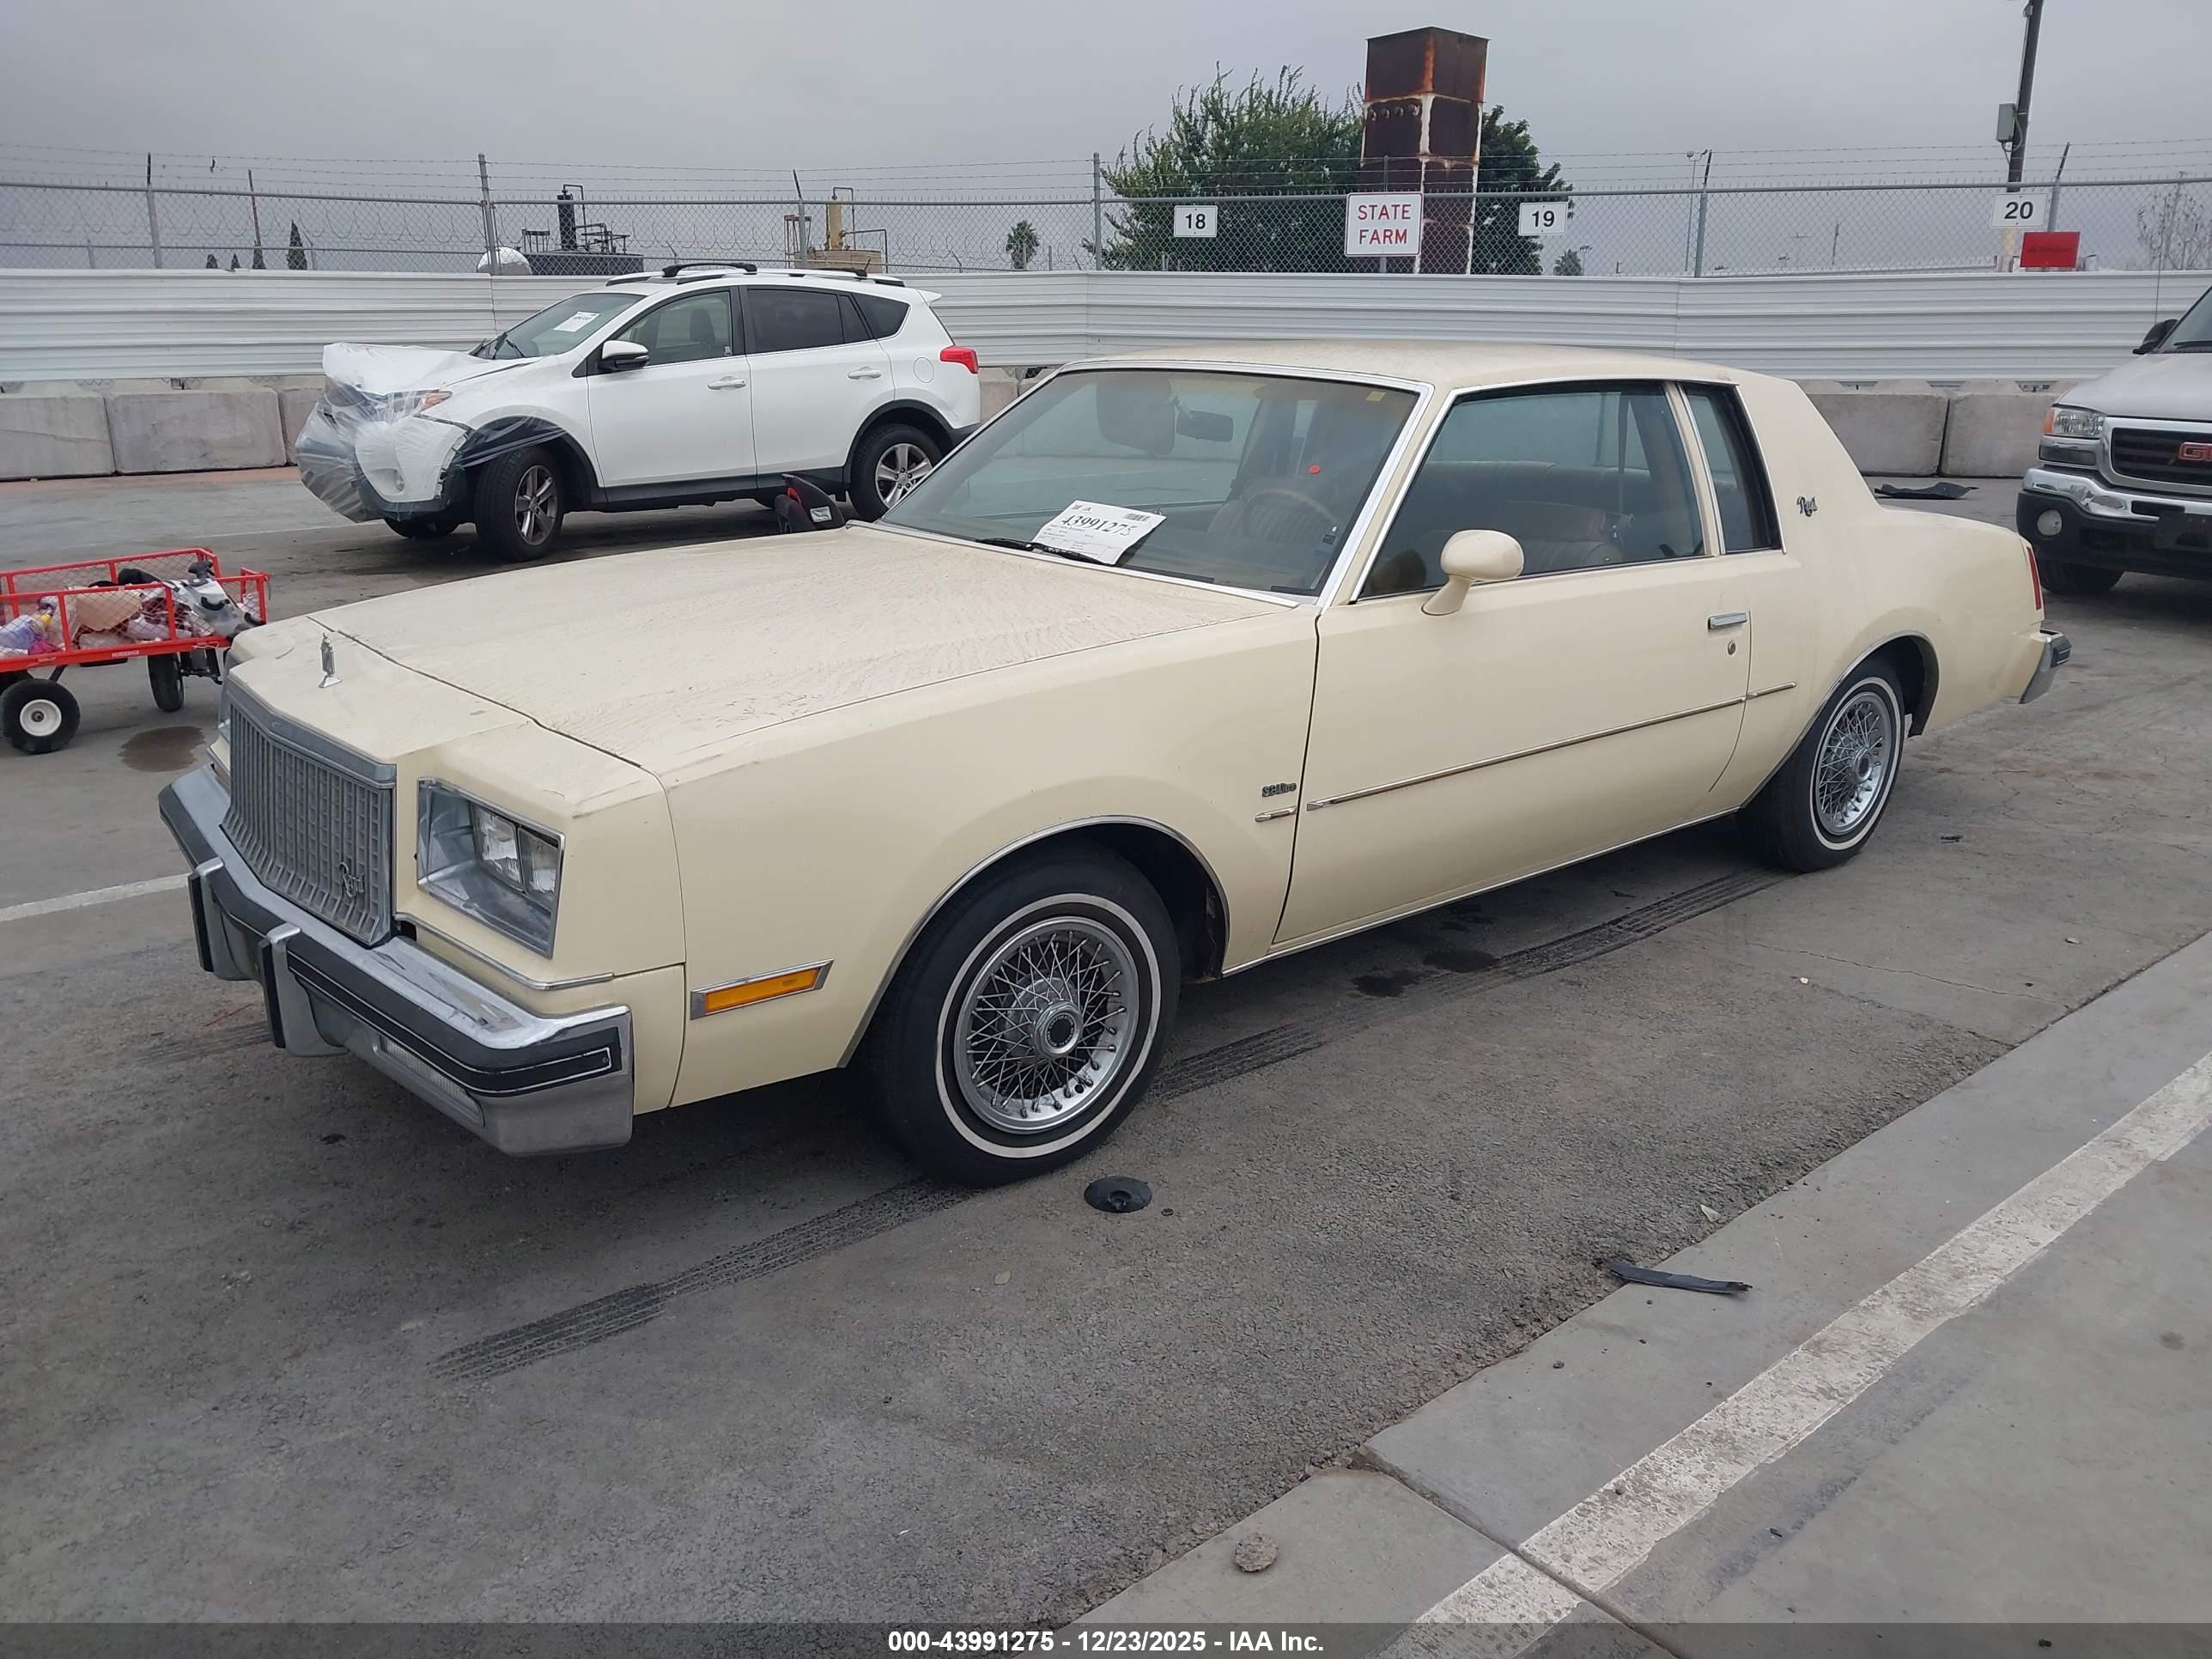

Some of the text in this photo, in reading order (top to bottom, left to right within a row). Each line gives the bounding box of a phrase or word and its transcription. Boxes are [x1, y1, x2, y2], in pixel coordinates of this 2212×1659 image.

[1357, 204, 1413, 221] STATE
[1531, 210, 1555, 228] 19
[2003, 201, 2033, 220] 20
[1185, 213, 1206, 230] 18
[1358, 228, 1408, 245] FARM
[1061, 514, 1139, 537] 43991275
